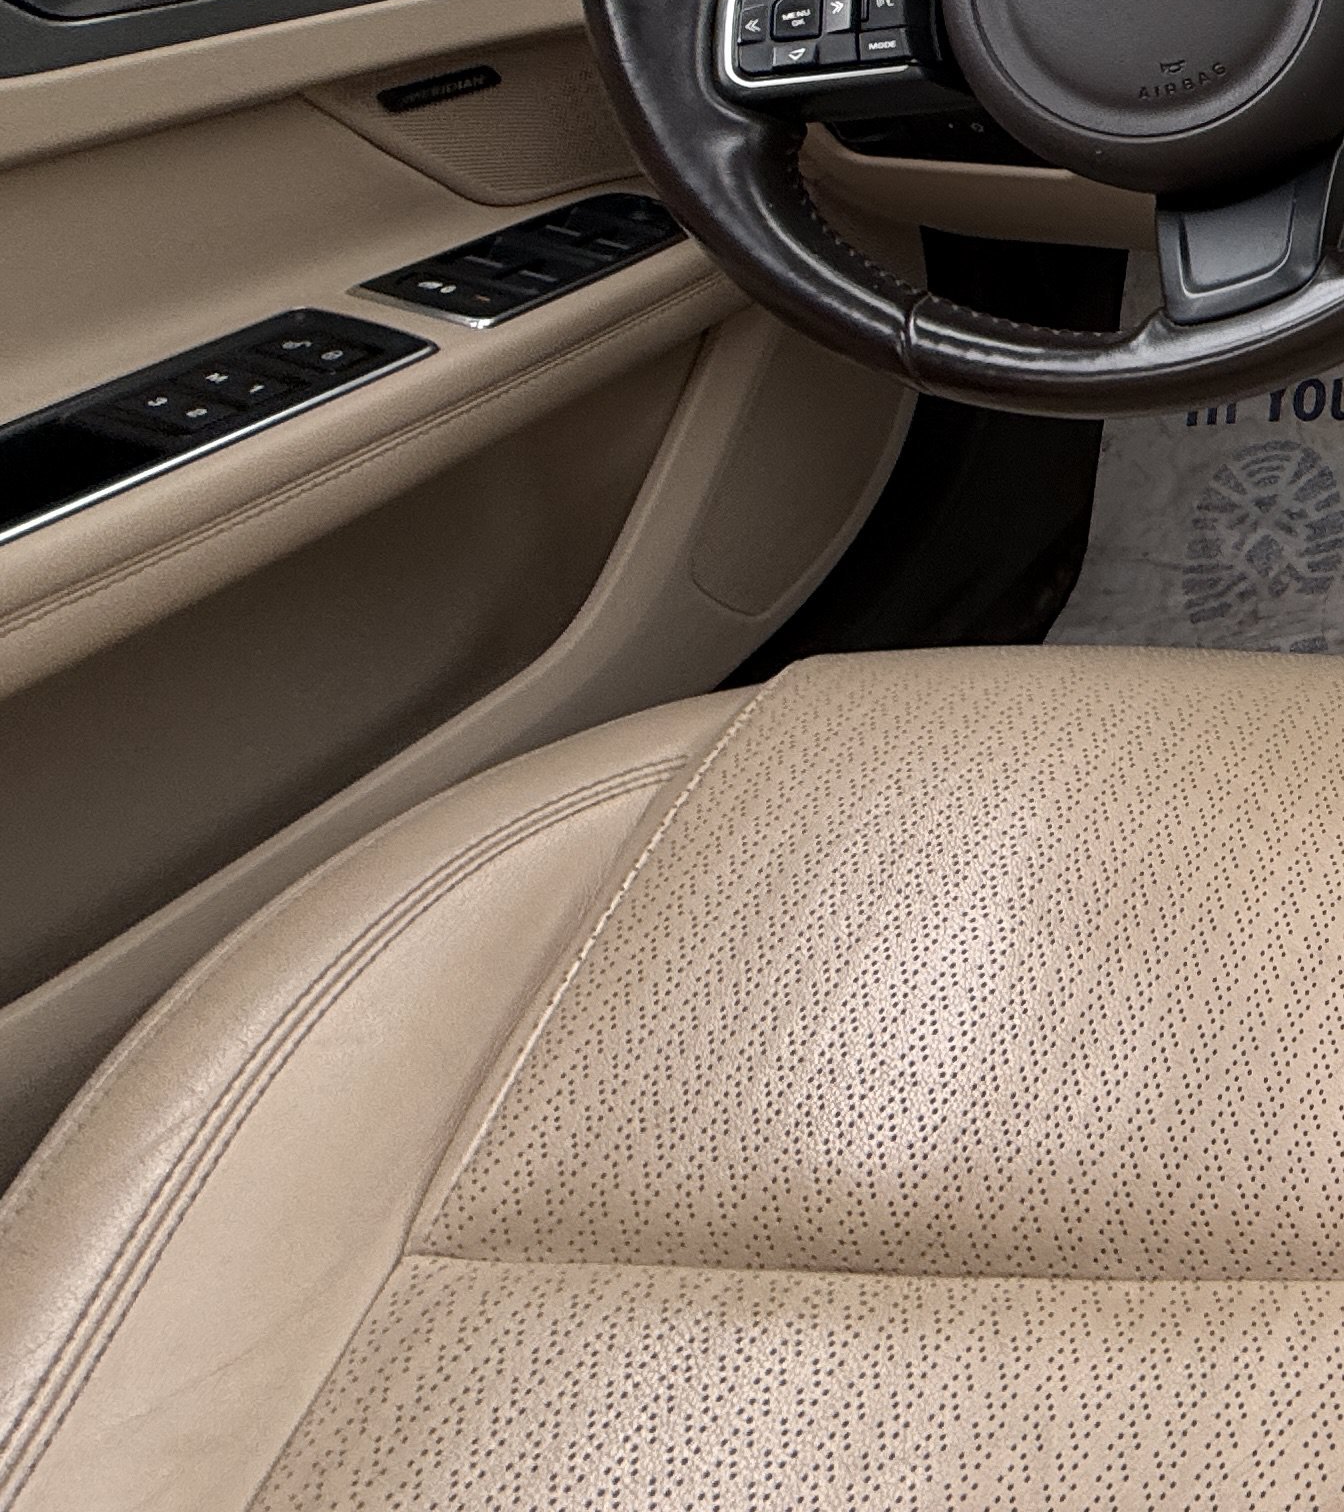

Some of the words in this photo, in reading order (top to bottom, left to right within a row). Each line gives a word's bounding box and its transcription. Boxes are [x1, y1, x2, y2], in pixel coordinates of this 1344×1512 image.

[781, 8, 812, 21] MENU
[791, 17, 806, 27] OK
[868, 40, 897, 50] MODE
[1139, 61, 1227, 100] AIRBAG
